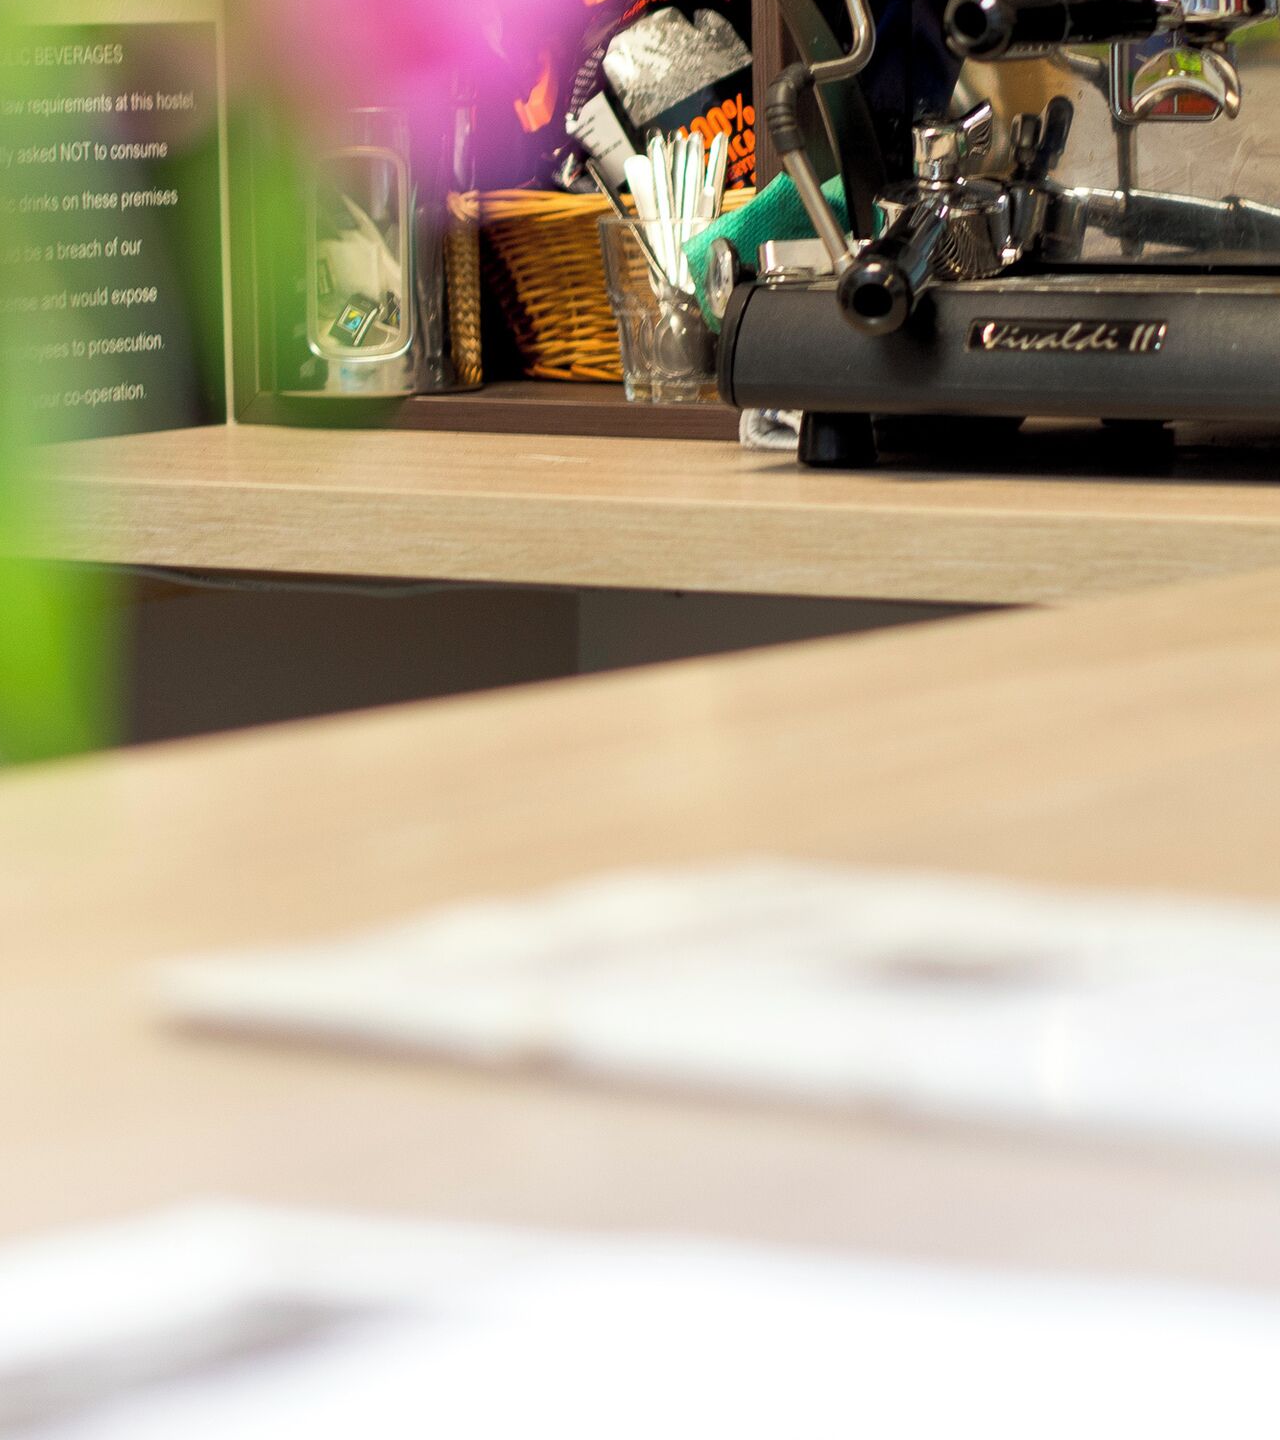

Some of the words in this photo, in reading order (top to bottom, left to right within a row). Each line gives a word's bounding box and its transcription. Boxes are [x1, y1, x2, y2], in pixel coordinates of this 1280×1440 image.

[35, 44, 124, 66] BEVERAGES
[27, 91, 112, 119] requirements
[115, 92, 129, 111] at
[130, 90, 153, 111] this
[17, 144, 57, 164] asked
[59, 141, 92, 162] NOT
[94, 140, 107, 161] to
[110, 141, 168, 160] consume
[20, 194, 58, 214] drinks
[62, 197, 78, 211] on
[81, 189, 117, 209] these
[121, 185, 178, 212] premises
[24, 247, 42, 263] be
[45, 248, 54, 261] a
[57, 240, 101, 260] breach
[104, 236, 118, 257] of
[120, 238, 143, 257] our
[40, 291, 67, 312] and
[70, 288, 108, 310] would
[111, 285, 158, 309] expose
[71, 339, 84, 358] to
[87, 332, 166, 360] prosecution.
[983, 322, 1119, 352] Vivaldi
[63, 381, 148, 409] co-operation.
